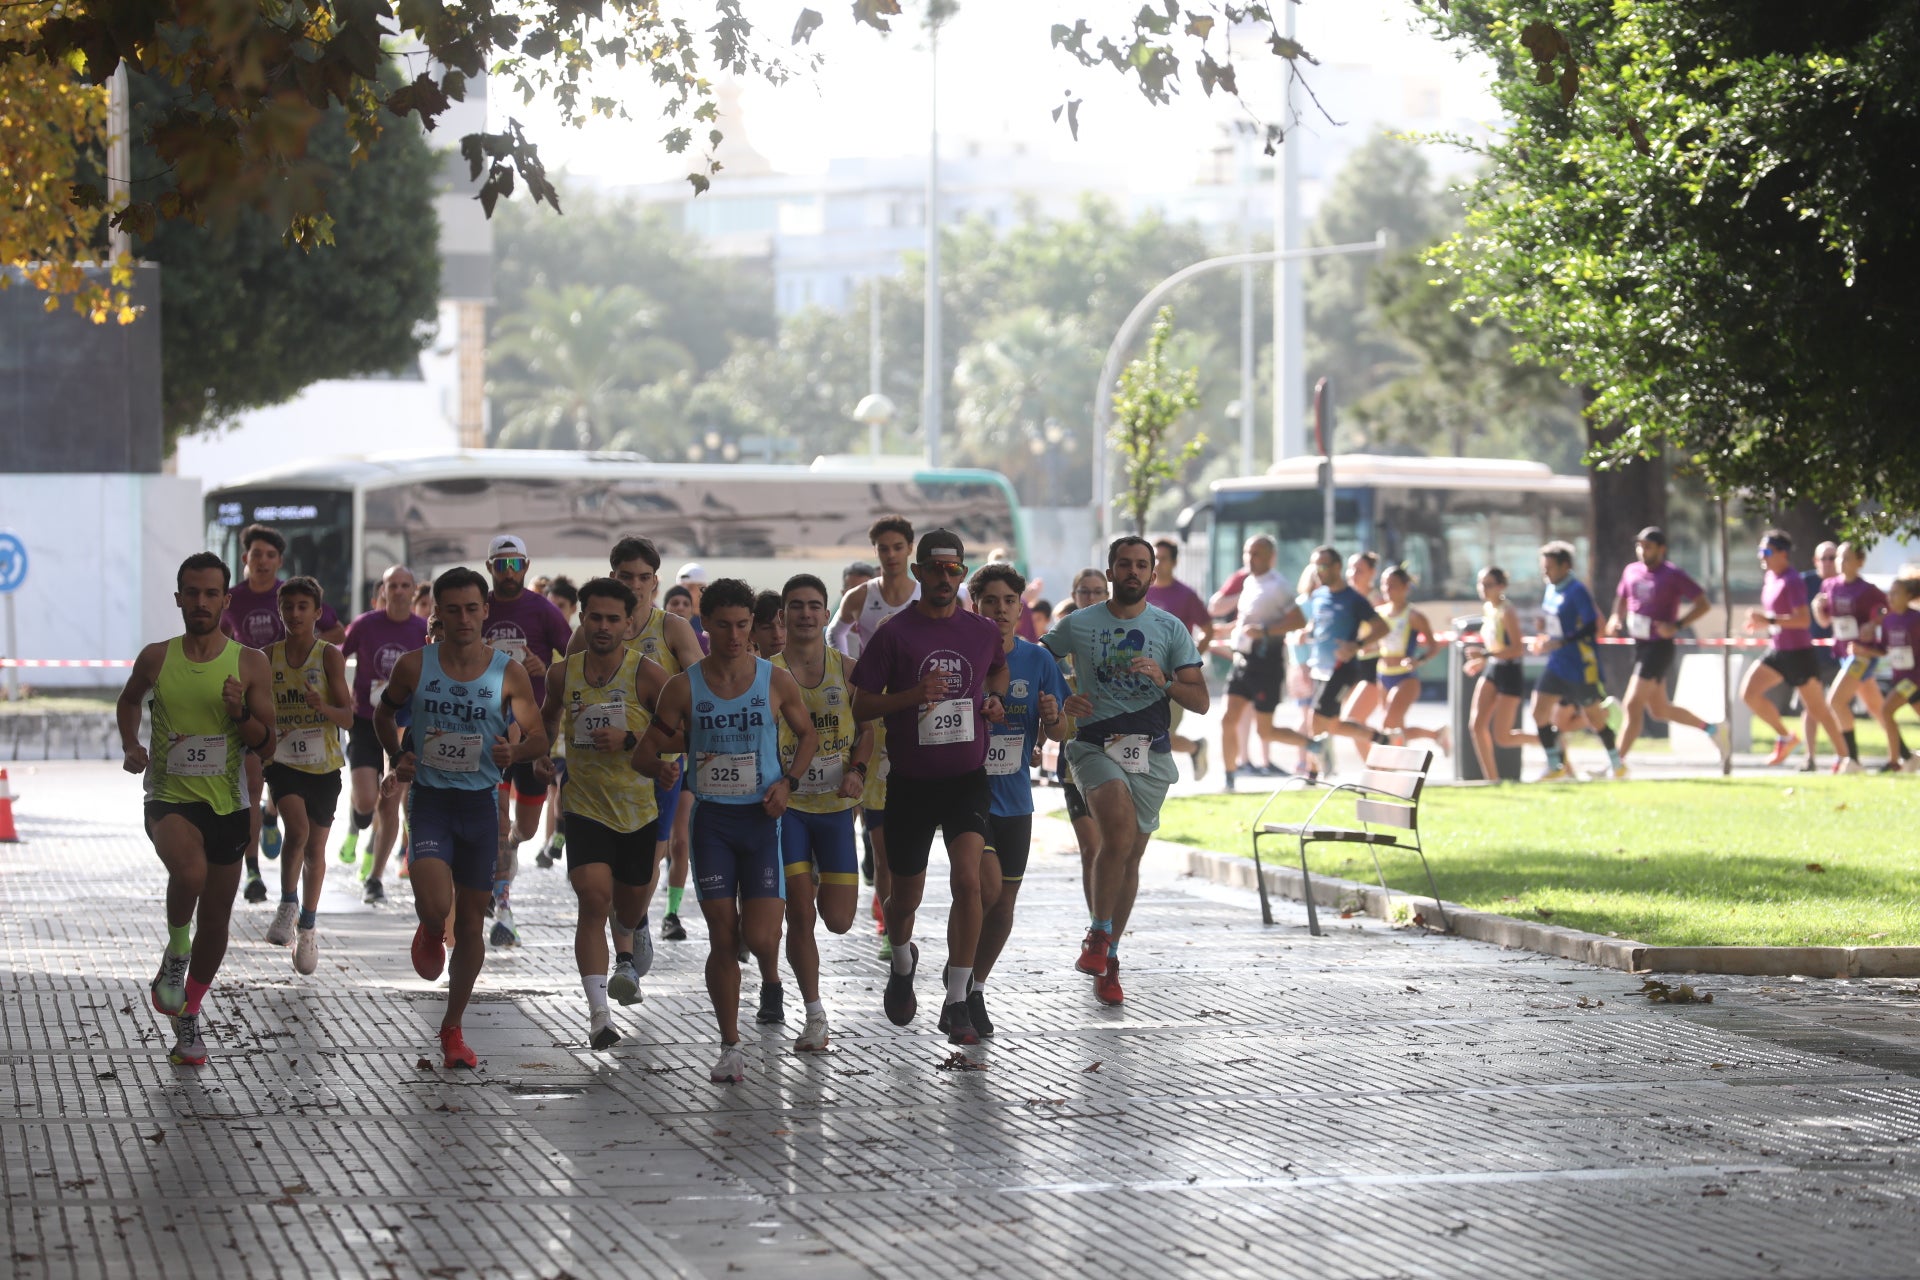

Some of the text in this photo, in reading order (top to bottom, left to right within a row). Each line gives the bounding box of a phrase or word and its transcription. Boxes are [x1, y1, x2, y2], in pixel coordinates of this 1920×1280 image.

[491, 628, 517, 640] 25N
[929, 658, 962, 672] 25N
[276, 688, 306, 703] LaMa
[424, 698, 487, 723] nerja
[585, 717, 610, 730] 378
[699, 707, 764, 732] nerja
[934, 714, 962, 729] 299
[292, 741, 307, 752] 18
[438, 744, 466, 759] 324
[187, 748, 206, 762] 35
[988, 748, 1006, 761] 90
[1123, 747, 1140, 760] 36
[711, 768, 740, 781] 325
[808, 769, 824, 781] 51
